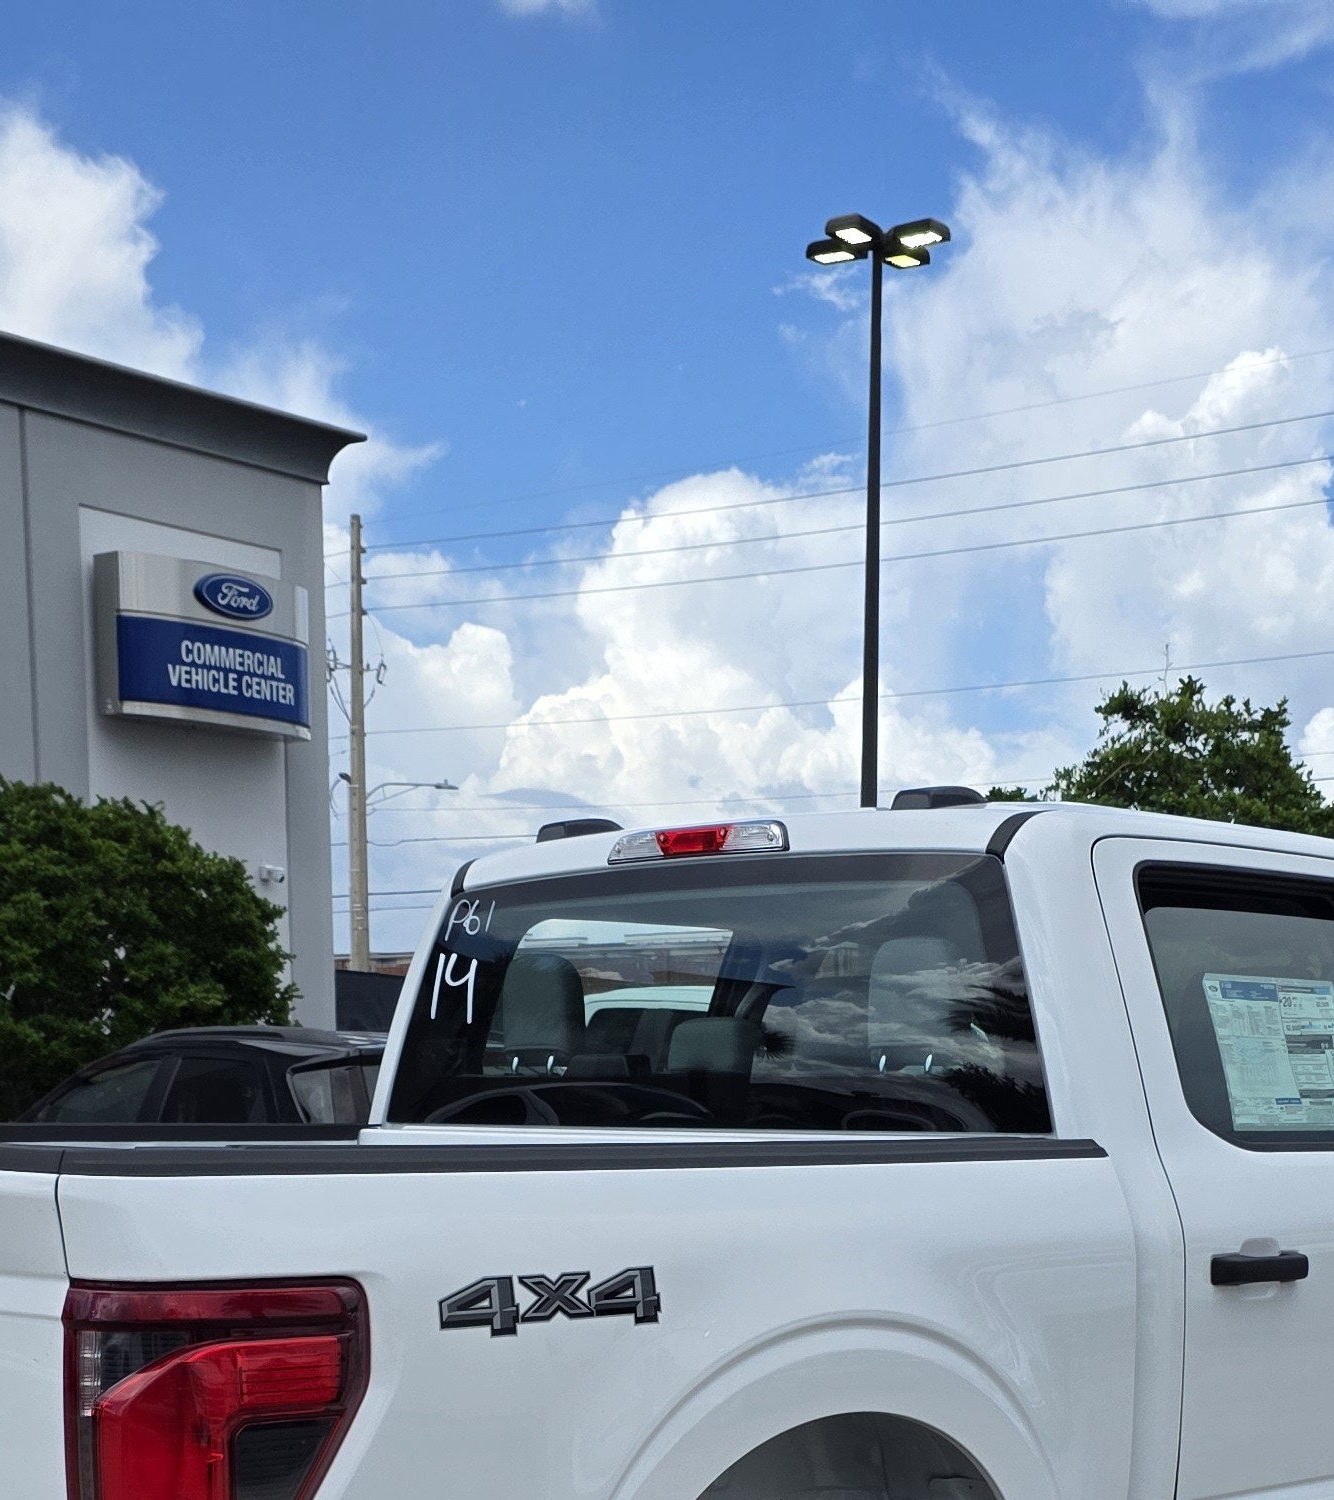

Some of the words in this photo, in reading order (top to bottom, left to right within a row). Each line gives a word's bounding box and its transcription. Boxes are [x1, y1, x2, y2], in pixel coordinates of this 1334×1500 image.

[217, 582, 259, 612] Ford
[180, 639, 286, 679] COMMERCIAL
[167, 663, 239, 696] VEHICLE
[241, 677, 295, 706] CENTER
